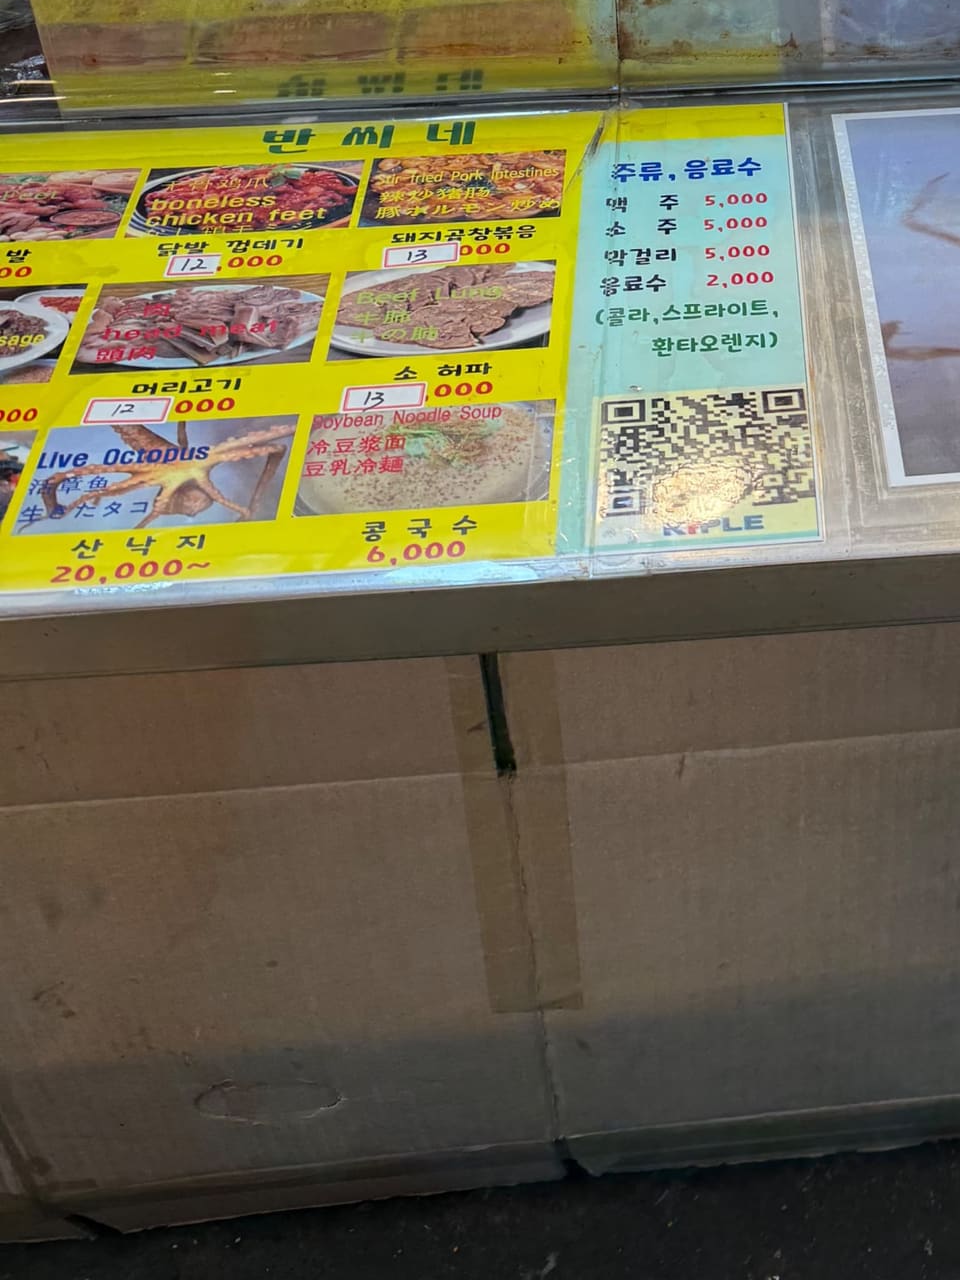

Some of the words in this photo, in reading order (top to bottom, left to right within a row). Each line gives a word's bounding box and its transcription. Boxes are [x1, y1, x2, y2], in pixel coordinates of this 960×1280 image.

[611, 161, 676, 183] 주류,
[683, 157, 763, 180] 음료수
[151, 195, 277, 211] boneless
[704, 192, 769, 209] 5,000
[145, 210, 254, 227] chicken
[269, 207, 328, 223] feet
[703, 216, 769, 233] 5,000
[391, 224, 537, 244] 돼지곱창볶음
[6, 249, 32, 263] 발
[225, 238, 303, 254] 껍데기
[406, 249, 428, 263] 13
[604, 247, 678, 267] 막걸리
[704, 244, 771, 262] 5,000
[180, 257, 207, 272] 12
[600, 274, 667, 297] 음료수
[706, 271, 775, 289] 2,000
[356, 288, 418, 305] Beef
[434, 285, 504, 302] Lung
[101, 324, 183, 341] head
[200, 319, 279, 337] meat
[651, 331, 779, 357] 환타오렌지)
[394, 365, 418, 381] 소
[437, 362, 493, 378] 허파
[131, 377, 242, 395] 머리고기
[111, 403, 136, 417] 12
[362, 391, 386, 412] 13
[393, 407, 451, 425] Noodle
[459, 405, 502, 420] Soup
[103, 445, 211, 468] Octopus
[366, 540, 467, 567] 6,000
